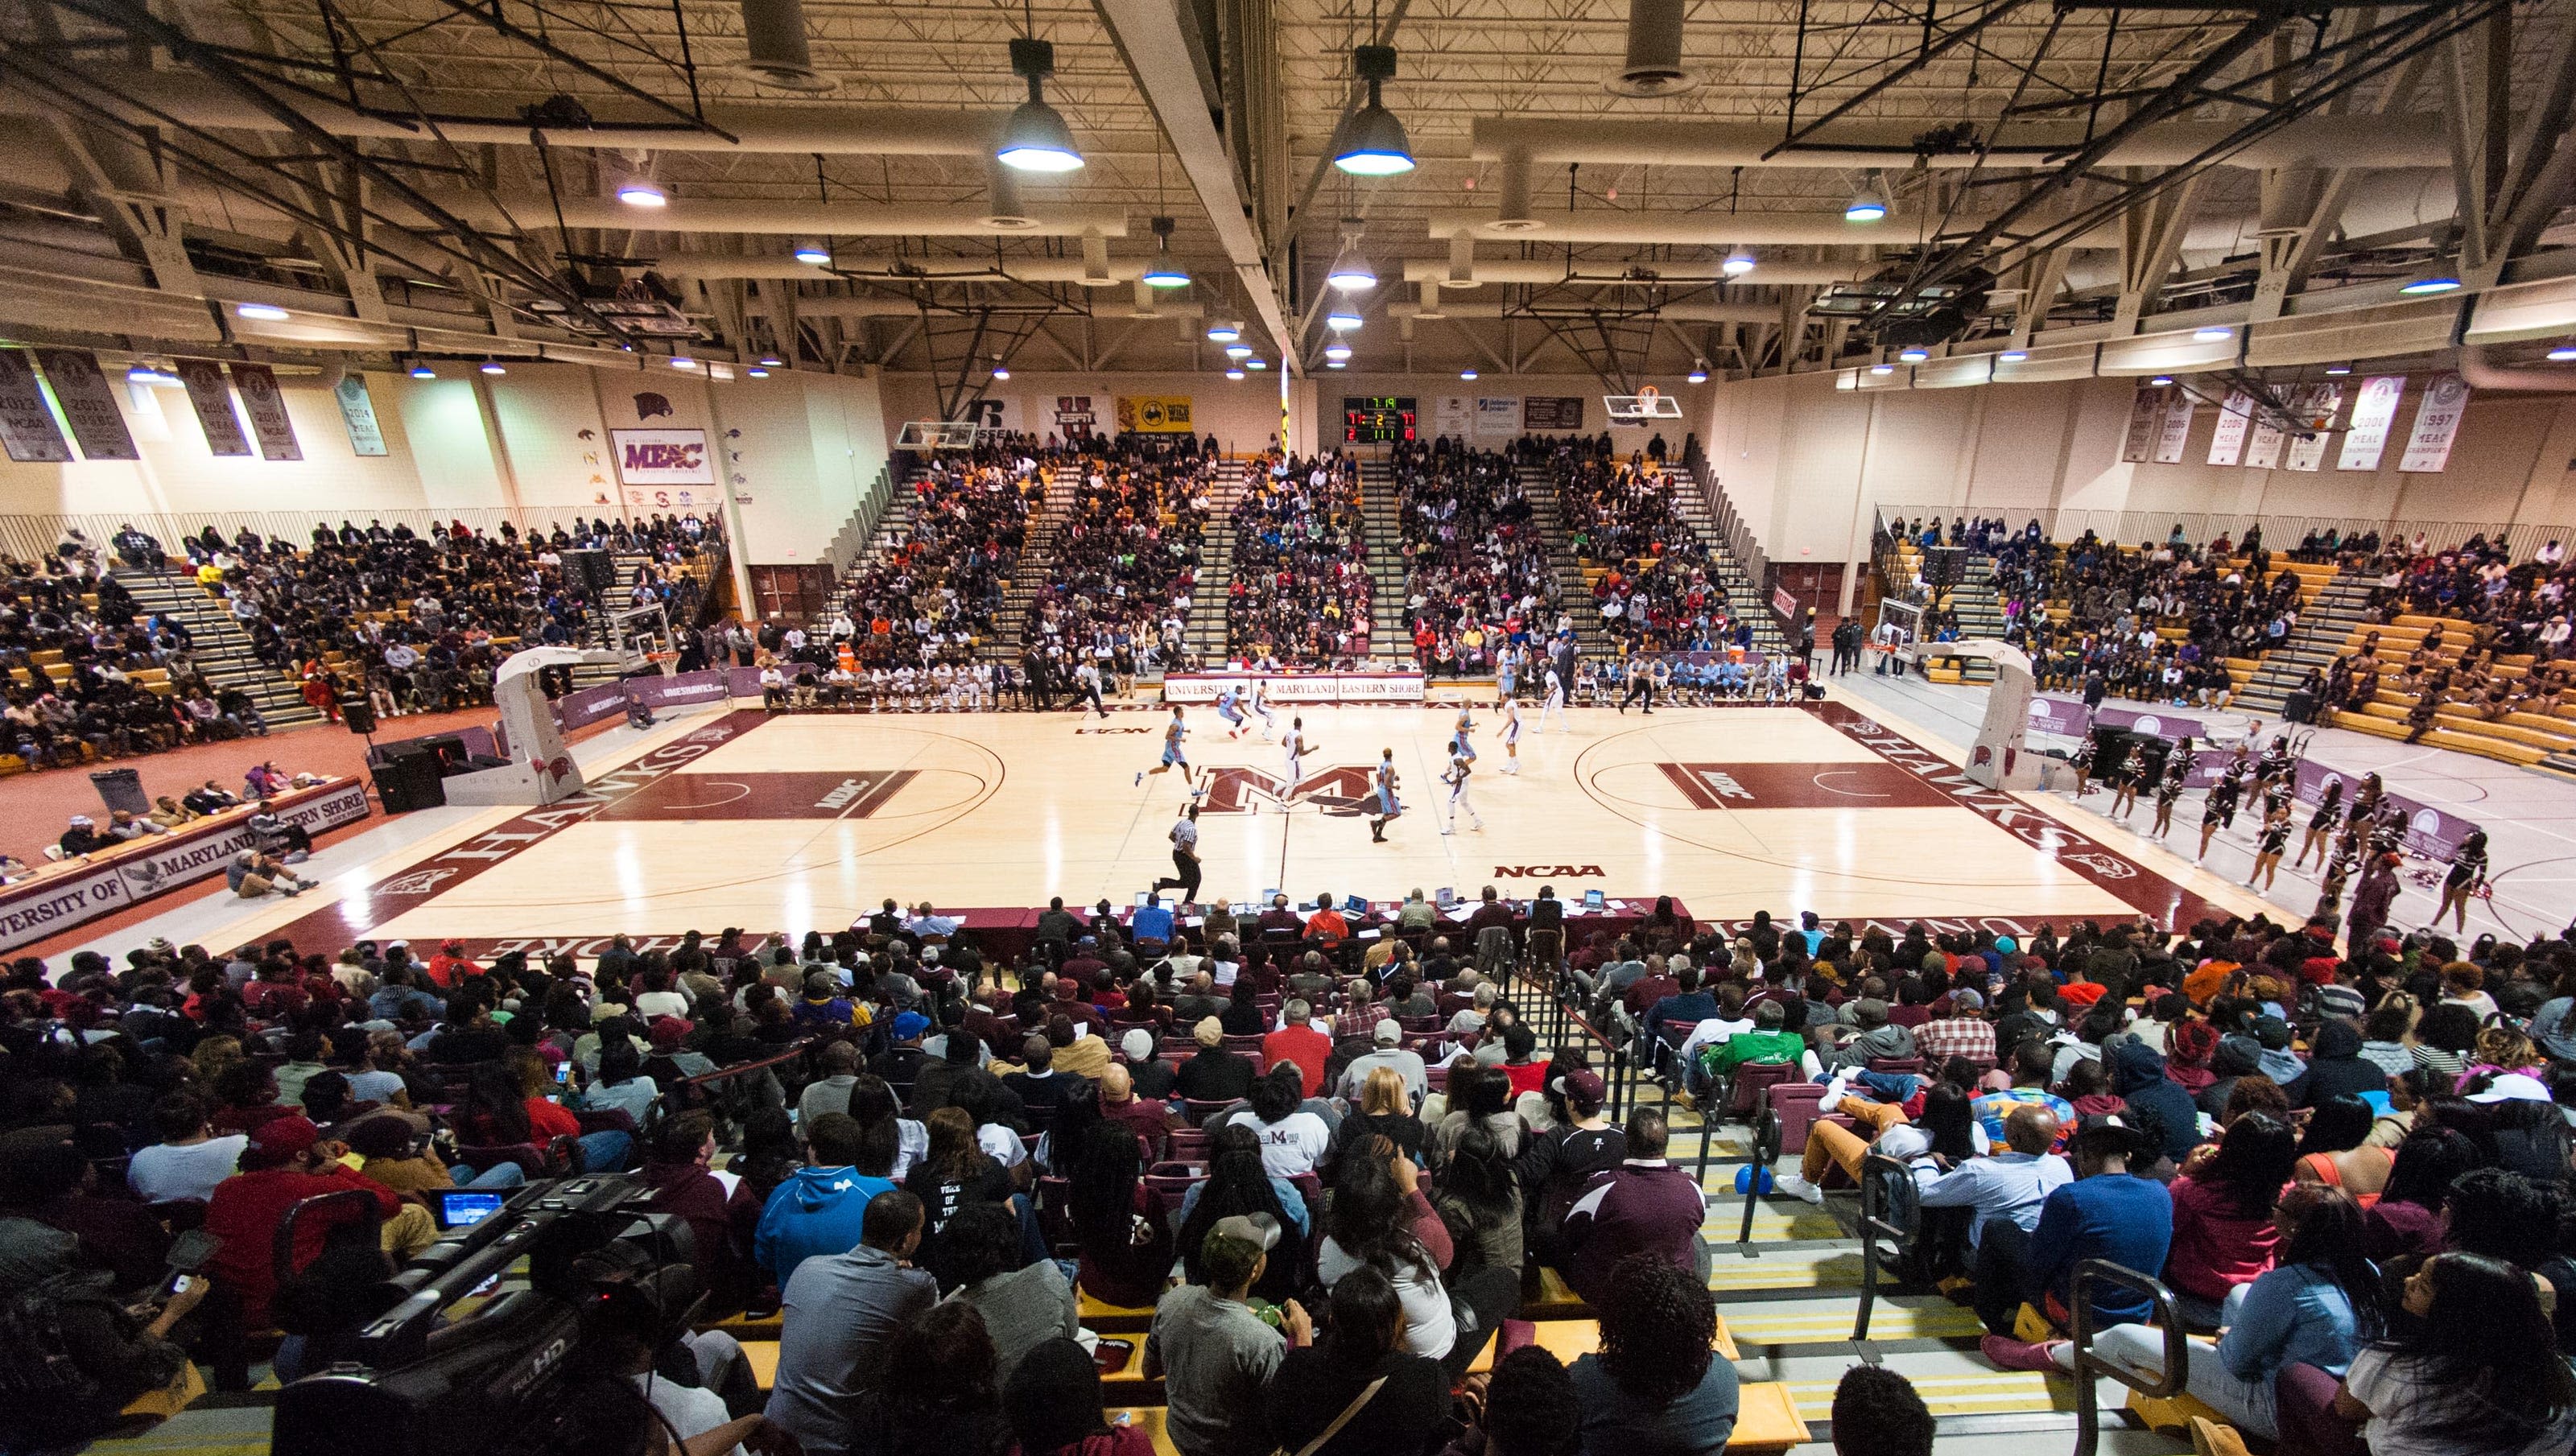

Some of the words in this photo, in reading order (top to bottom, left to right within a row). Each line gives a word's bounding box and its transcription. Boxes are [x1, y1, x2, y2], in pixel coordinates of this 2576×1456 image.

[348, 409, 370, 419] 2014
[1059, 413, 1092, 423] ESPN
[1377, 414, 1384, 426] 2
[2357, 417, 2385, 427] 2000
[2422, 415, 2454, 427] 1997
[2352, 435, 2380, 443] MEAC
[2417, 434, 2446, 443] MEAC
[625, 443, 704, 472] MEAC
[1168, 685, 1230, 695] UNIVERSITY
[1276, 684, 1335, 695] MARYLAND
[1342, 684, 1386, 694] EASTERN
[1389, 684, 1422, 694] SHORE
[1698, 769, 1756, 800] MEAC
[815, 778, 870, 810] MEAC
[1858, 737, 2091, 849] HAWKS
[435, 744, 709, 862] HAWKS
[283, 807, 320, 827] TERN
[320, 792, 364, 819] SHORE
[162, 831, 256, 877] MARYLAND
[1494, 864, 1606, 878] NCAA
[94, 877, 121, 903] OF
[1259, 1130, 1299, 1144] COMING
[939, 1184, 960, 1194] VOICE
[945, 1195, 955, 1206] OF
[534, 1338, 566, 1374] HD
